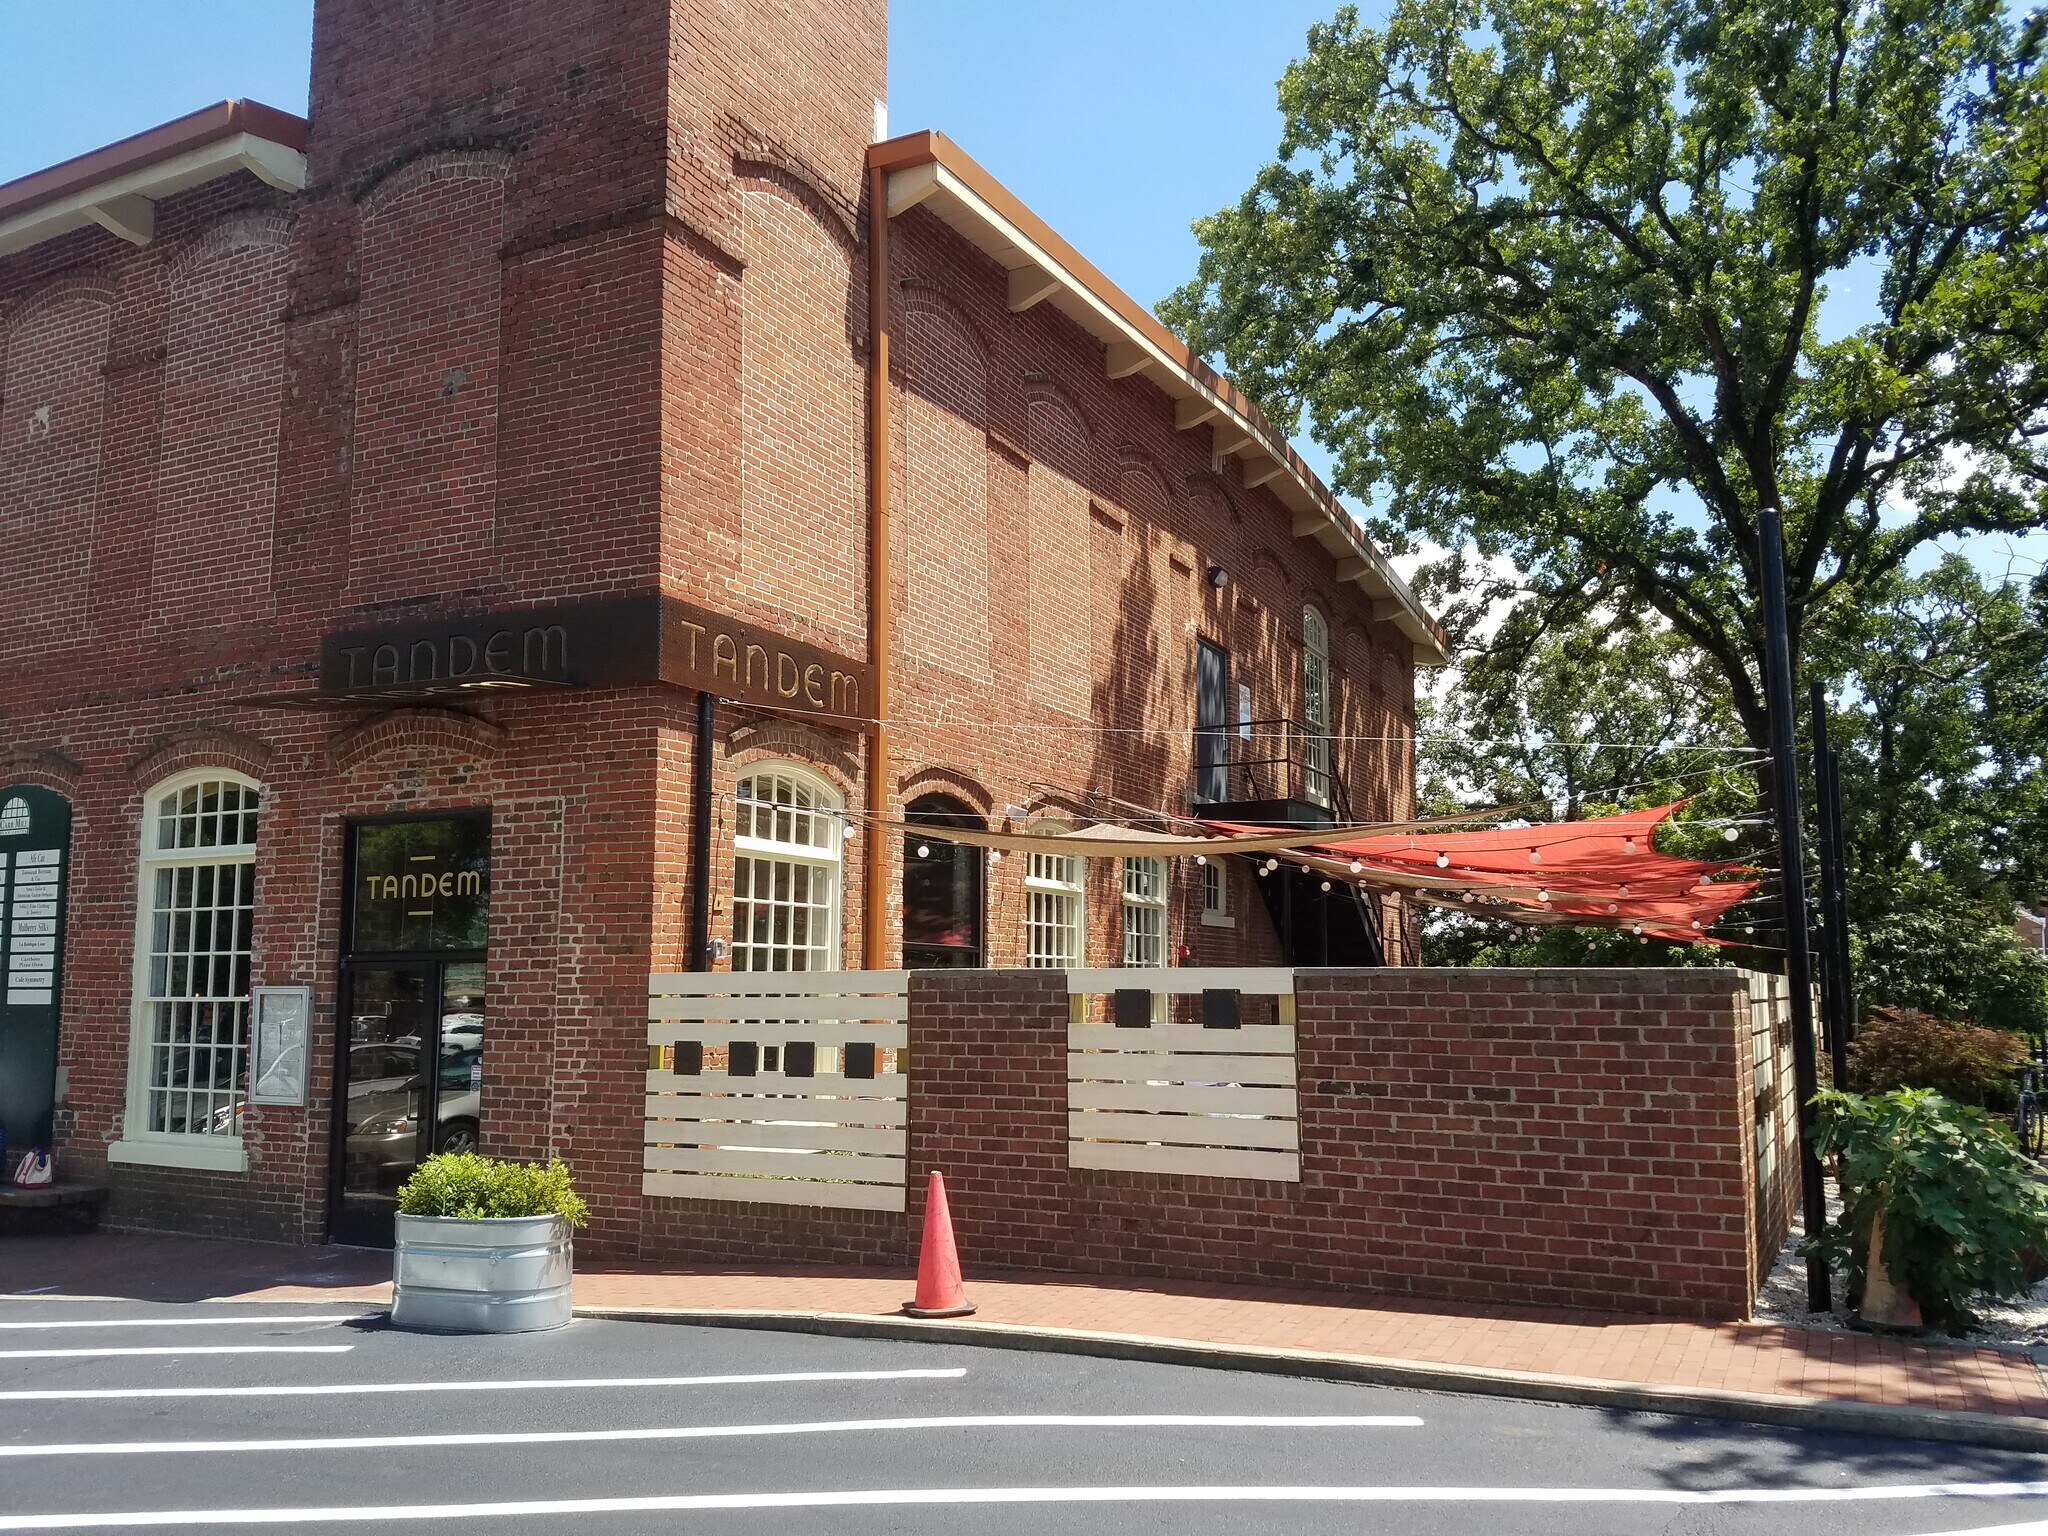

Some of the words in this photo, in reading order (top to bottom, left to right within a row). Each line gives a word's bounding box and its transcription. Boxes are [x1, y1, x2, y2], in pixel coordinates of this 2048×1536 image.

[340, 624, 568, 688] TANDEM
[681, 619, 870, 716] TANDEM
[366, 870, 481, 900] TANDEM
[18, 922, 36, 933] Mulberry
[38, 922, 48, 932] Silks
